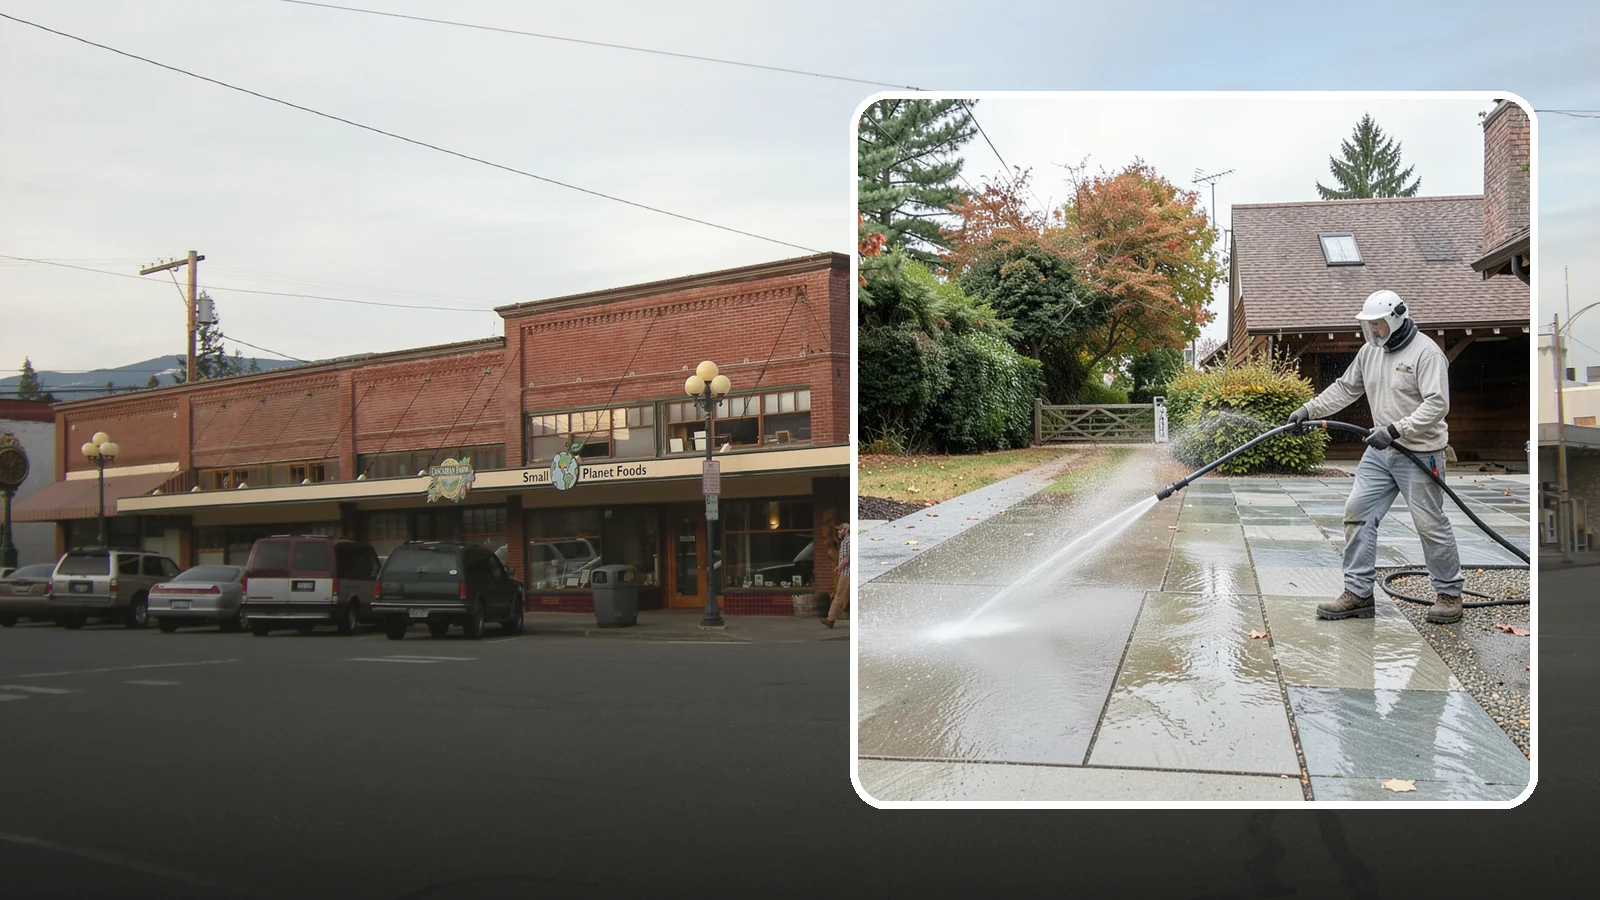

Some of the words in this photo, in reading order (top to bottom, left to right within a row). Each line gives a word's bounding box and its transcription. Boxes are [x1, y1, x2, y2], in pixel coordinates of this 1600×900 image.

[523, 471, 549, 483] Small
[583, 468, 614, 479] Planet
[617, 464, 647, 477] Foods
